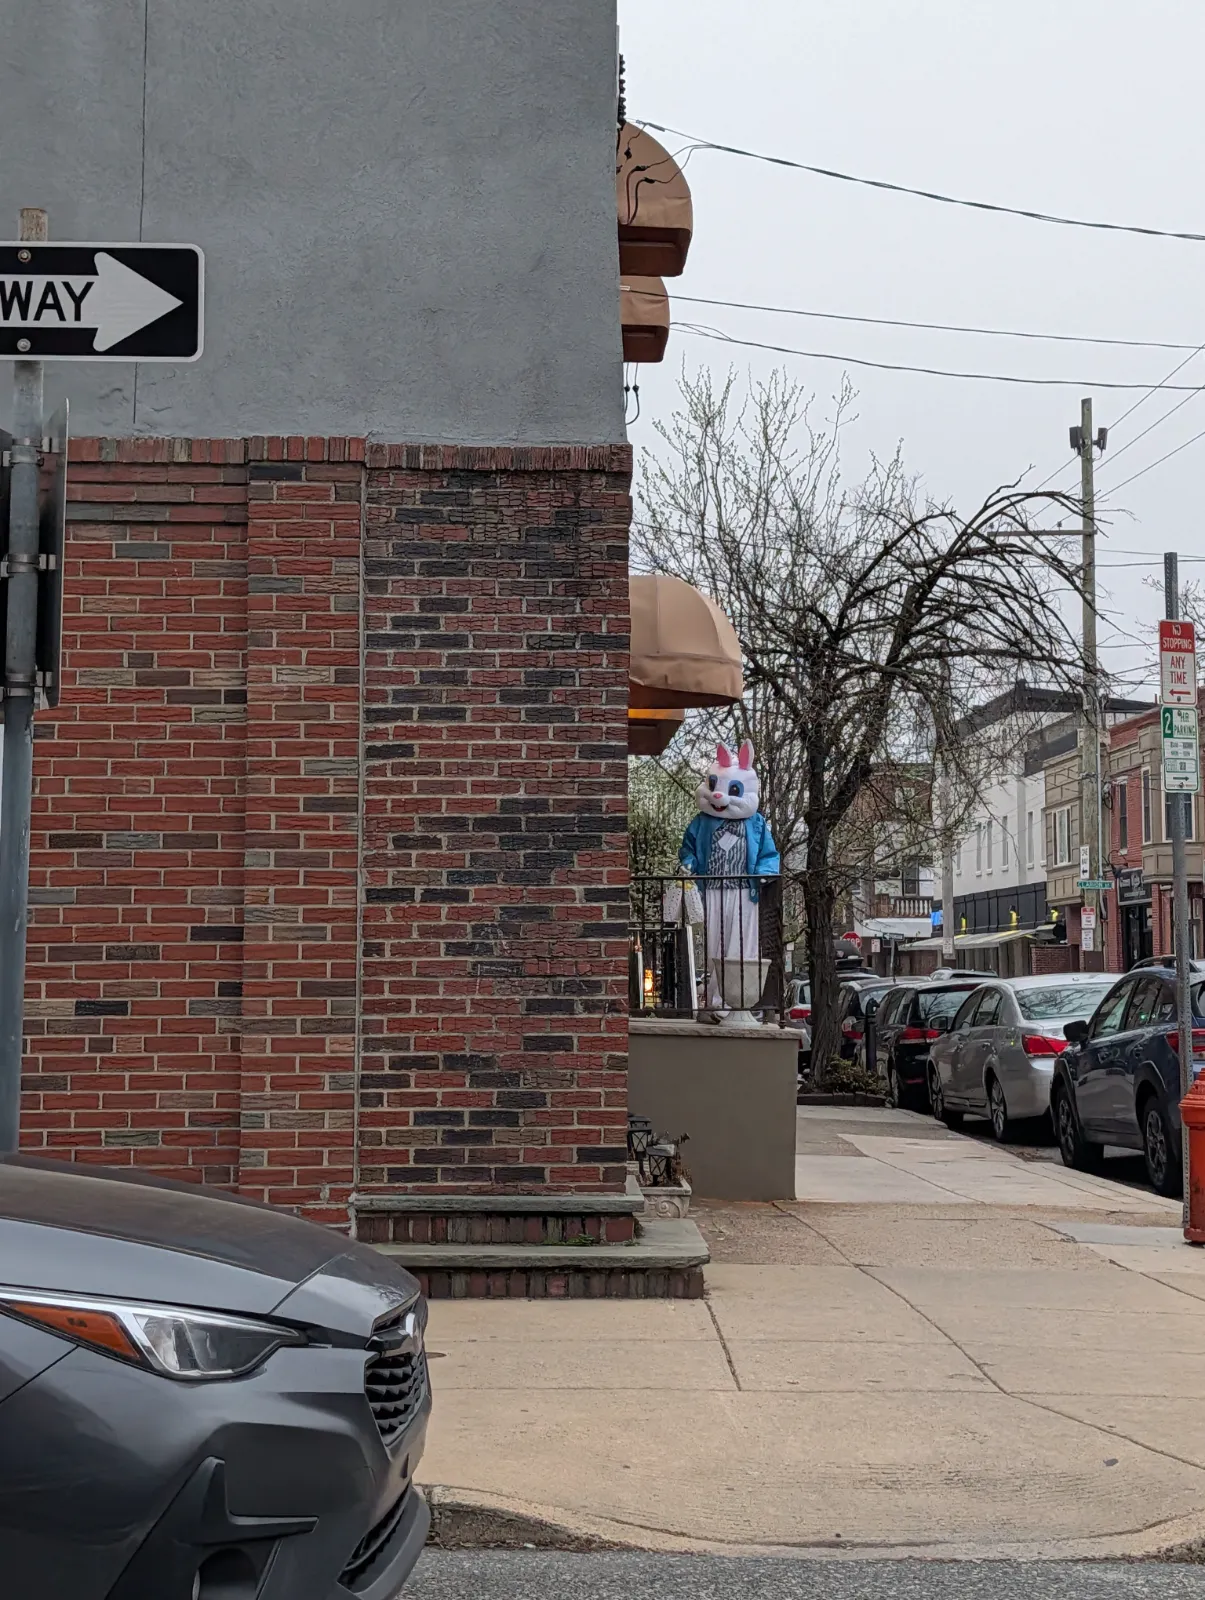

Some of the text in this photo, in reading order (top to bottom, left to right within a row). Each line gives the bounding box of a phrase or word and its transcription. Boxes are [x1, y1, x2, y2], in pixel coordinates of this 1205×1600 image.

[0, 281, 95, 322] WAY
[1172, 624, 1182, 636] NO
[1162, 637, 1193, 650] STOPPING
[1170, 655, 1185, 669] ANY
[1169, 671, 1188, 685] TIME
[1164, 712, 1190, 734] 2 HR
[1174, 725, 1195, 736] PARKING
